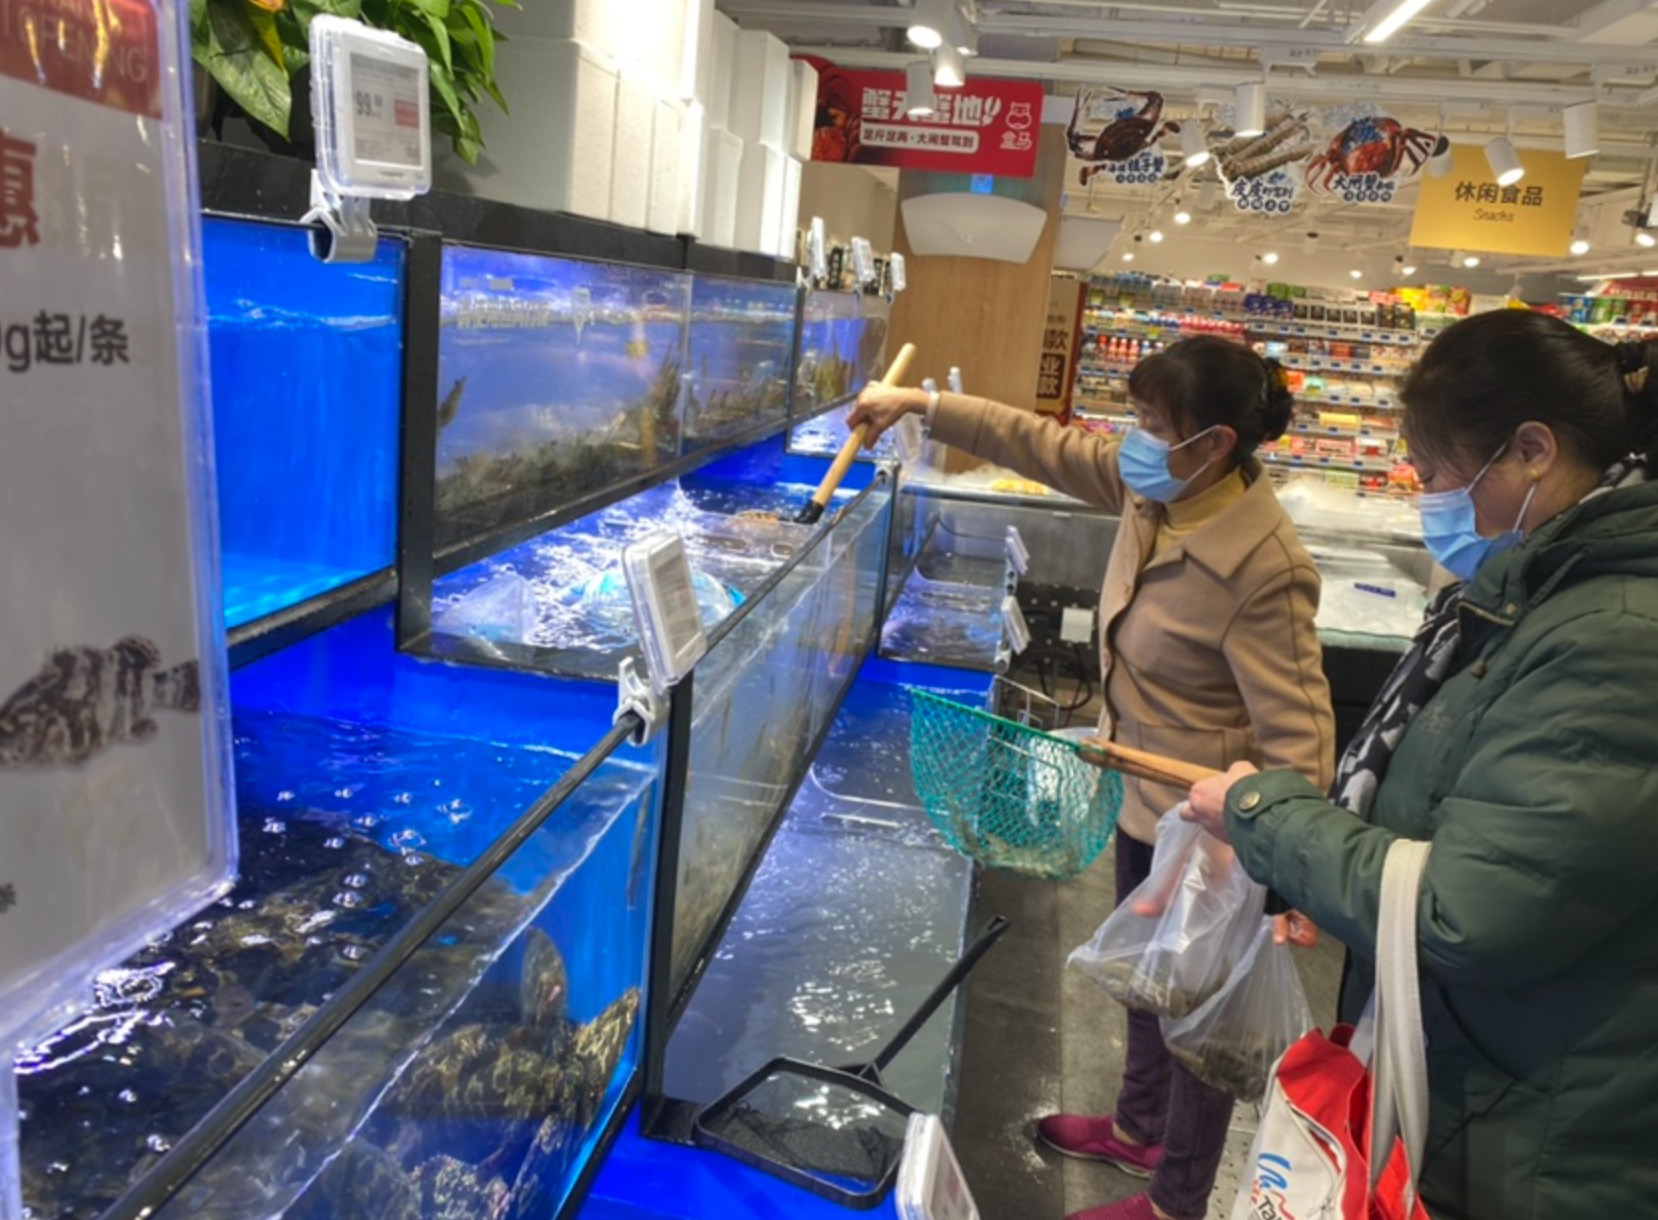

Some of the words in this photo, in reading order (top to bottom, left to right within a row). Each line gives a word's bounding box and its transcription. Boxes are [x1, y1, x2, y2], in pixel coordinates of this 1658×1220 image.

[19, 6, 147, 83] OPENNG
[1001, 131, 1032, 151] 盒马
[1455, 181, 1543, 207] 休闲食品
[1473, 208, 1515, 222] Snacks
[0, 309, 129, 373] g起/条
